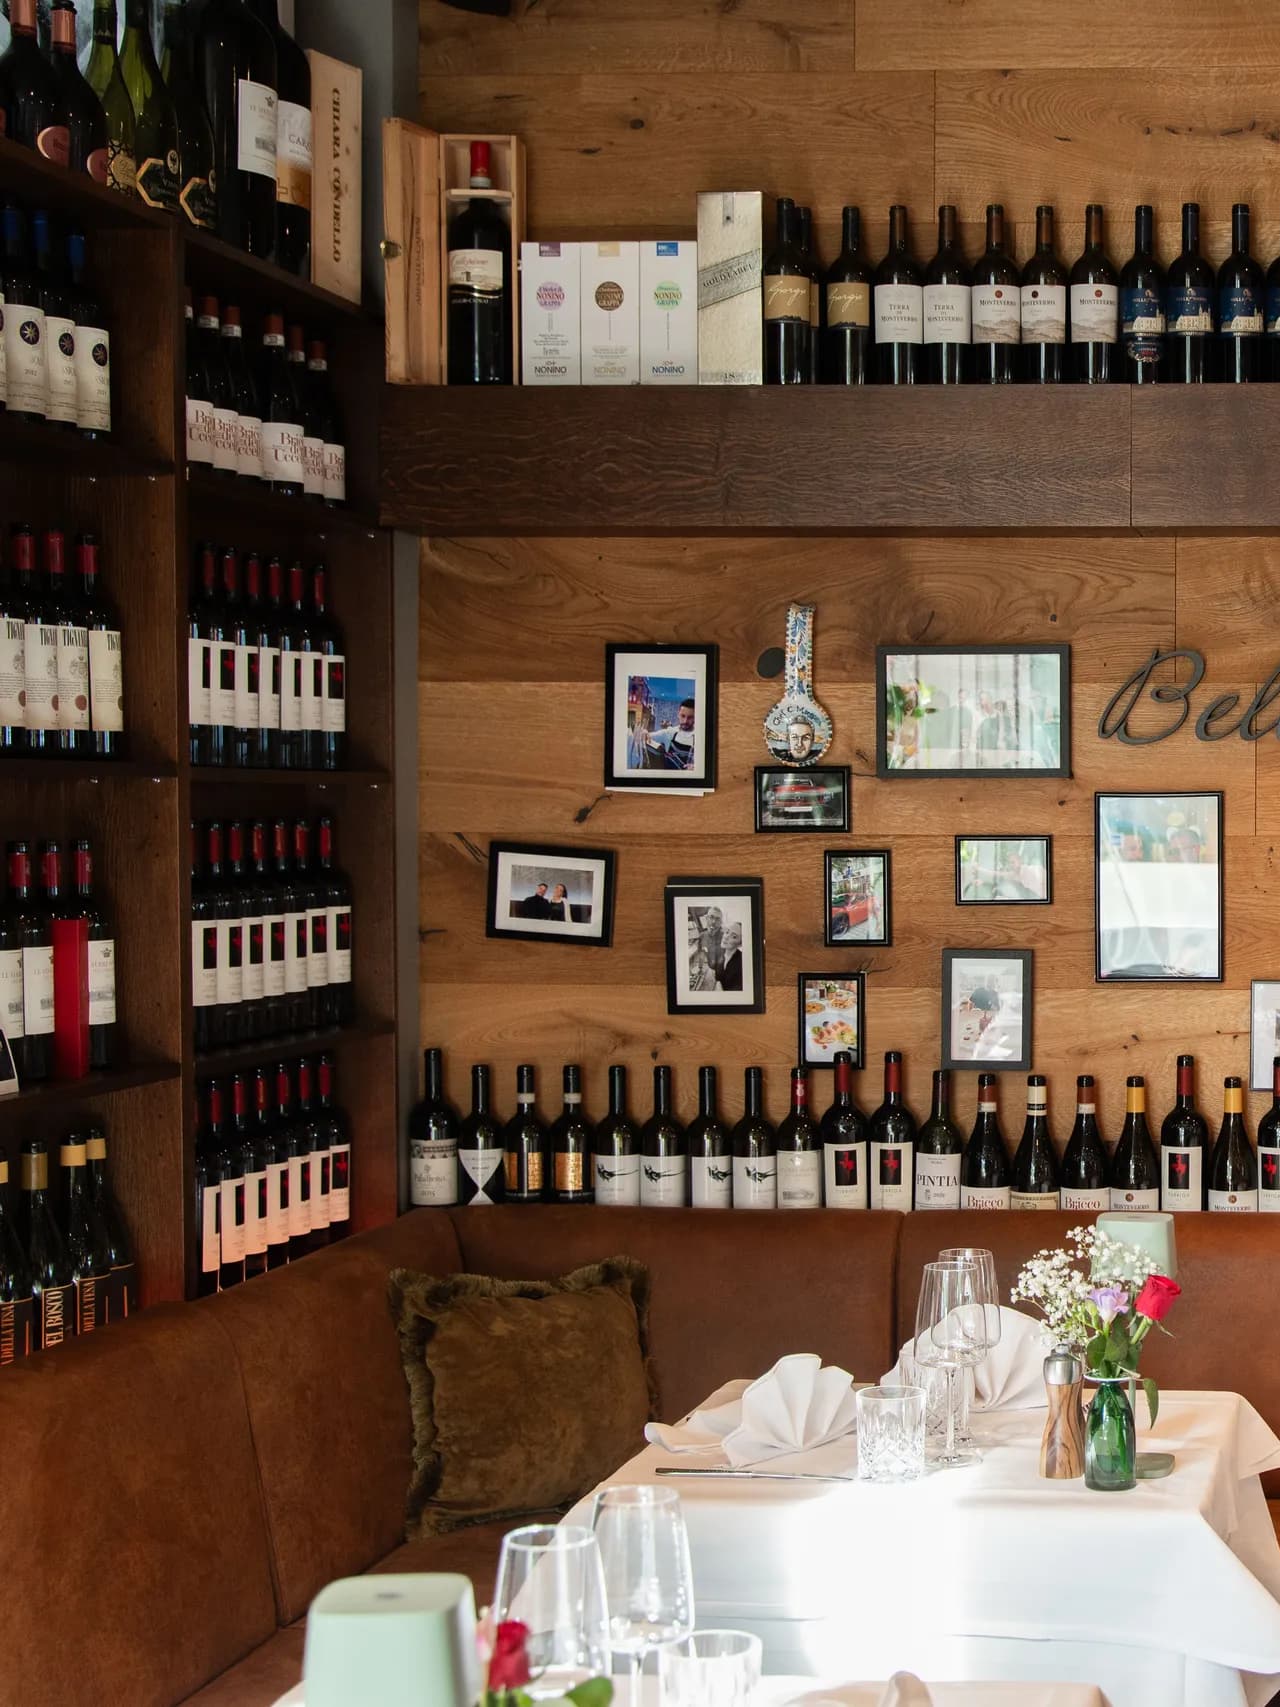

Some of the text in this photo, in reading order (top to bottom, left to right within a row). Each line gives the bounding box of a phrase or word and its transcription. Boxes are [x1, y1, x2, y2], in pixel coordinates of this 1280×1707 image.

[332, 87, 342, 160] CHIARA
[702, 262, 753, 289] GOLD LABEL
[537, 292, 565, 300] NONINO
[654, 292, 682, 300] NONINO
[534, 366, 568, 374] NONINO
[652, 366, 685, 374] NONINO
[917, 1174, 959, 1187] PINTIA
[967, 1195, 1004, 1209] Bricco
[1065, 1196, 1101, 1209] Bricco
[46, 1290, 64, 1328] BOSCO
